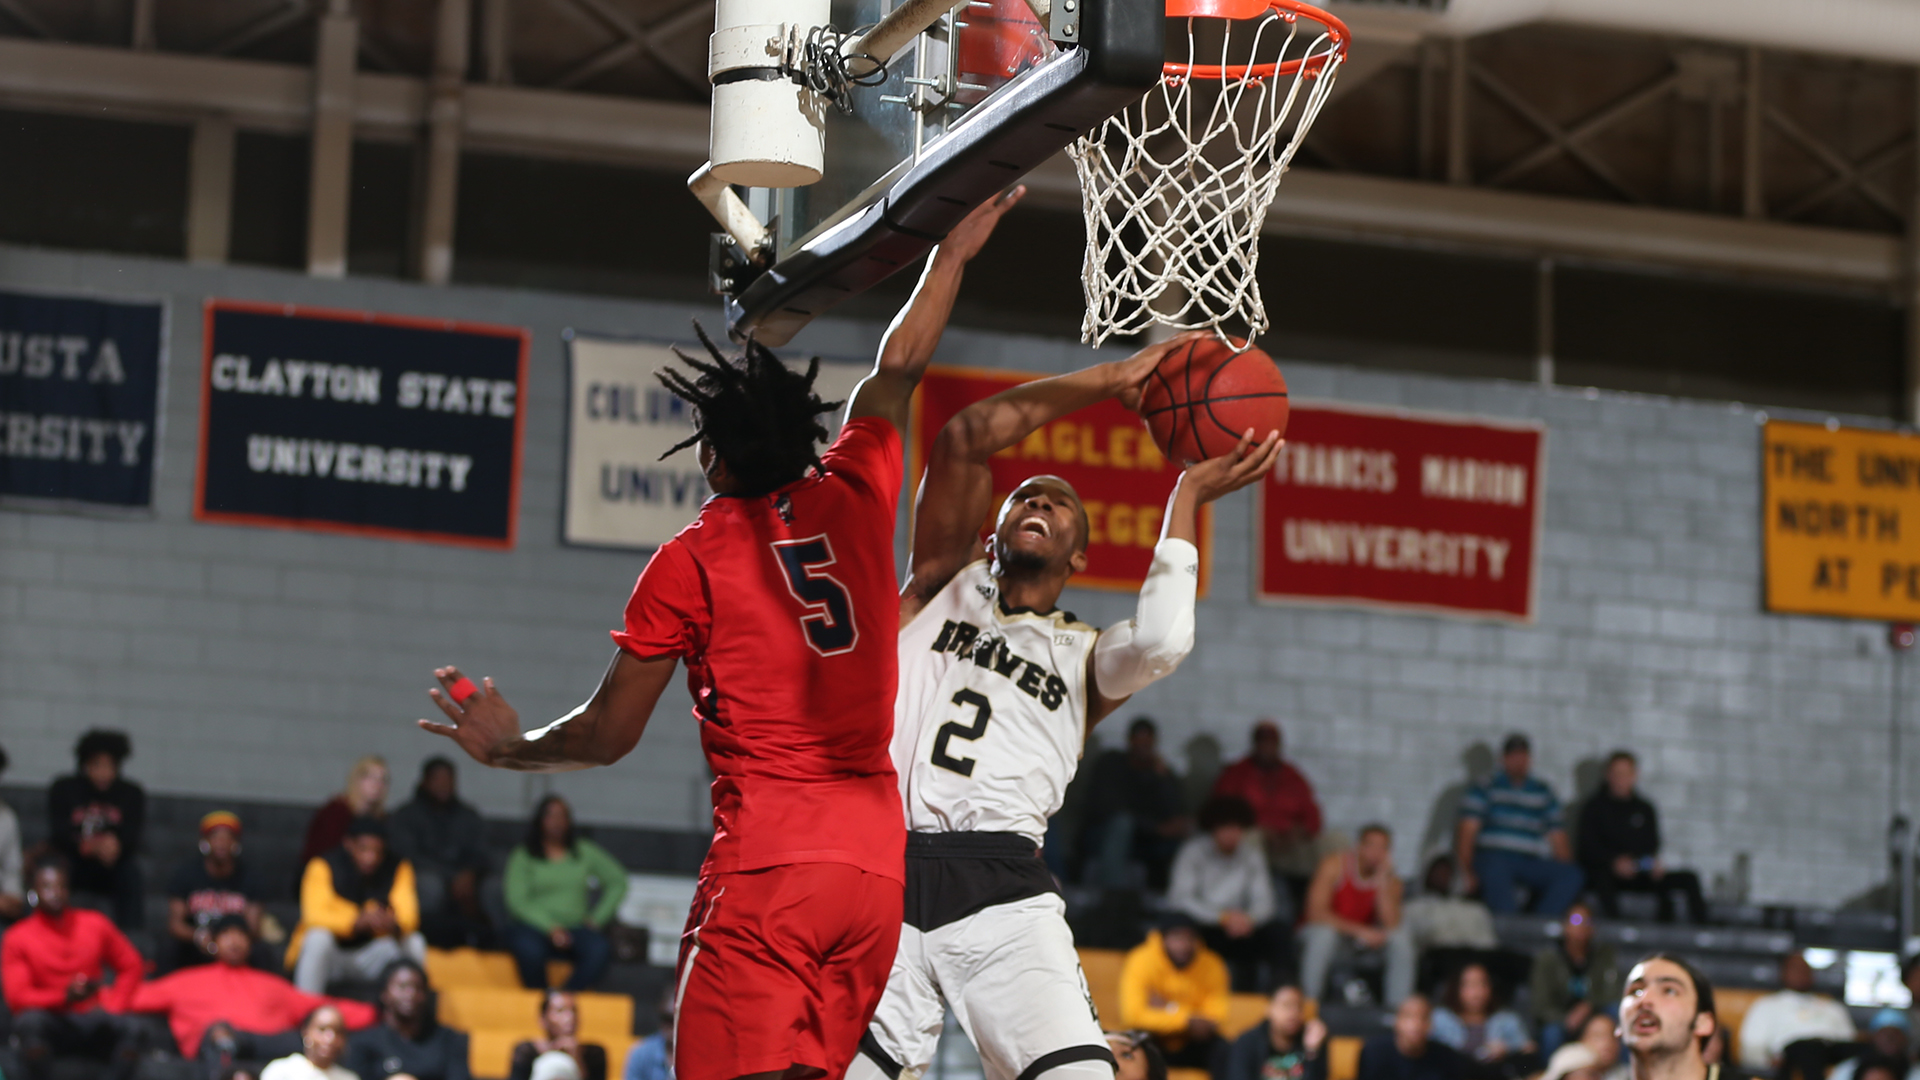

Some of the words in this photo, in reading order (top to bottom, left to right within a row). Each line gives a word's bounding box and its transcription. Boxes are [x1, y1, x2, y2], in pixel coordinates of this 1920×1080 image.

[211, 353, 382, 404] CLAYTON
[397, 371, 516, 418] STATE
[247, 434, 473, 492] UNIVERSITY
[1420, 453, 1527, 506] MARION
[1772, 440, 1834, 485] THE
[1283, 516, 1510, 580] UNIVERSITY
[1777, 498, 1900, 544] NORTH
[769, 532, 860, 658] 5
[1812, 555, 1851, 593] AT
[930, 687, 992, 778] 2
